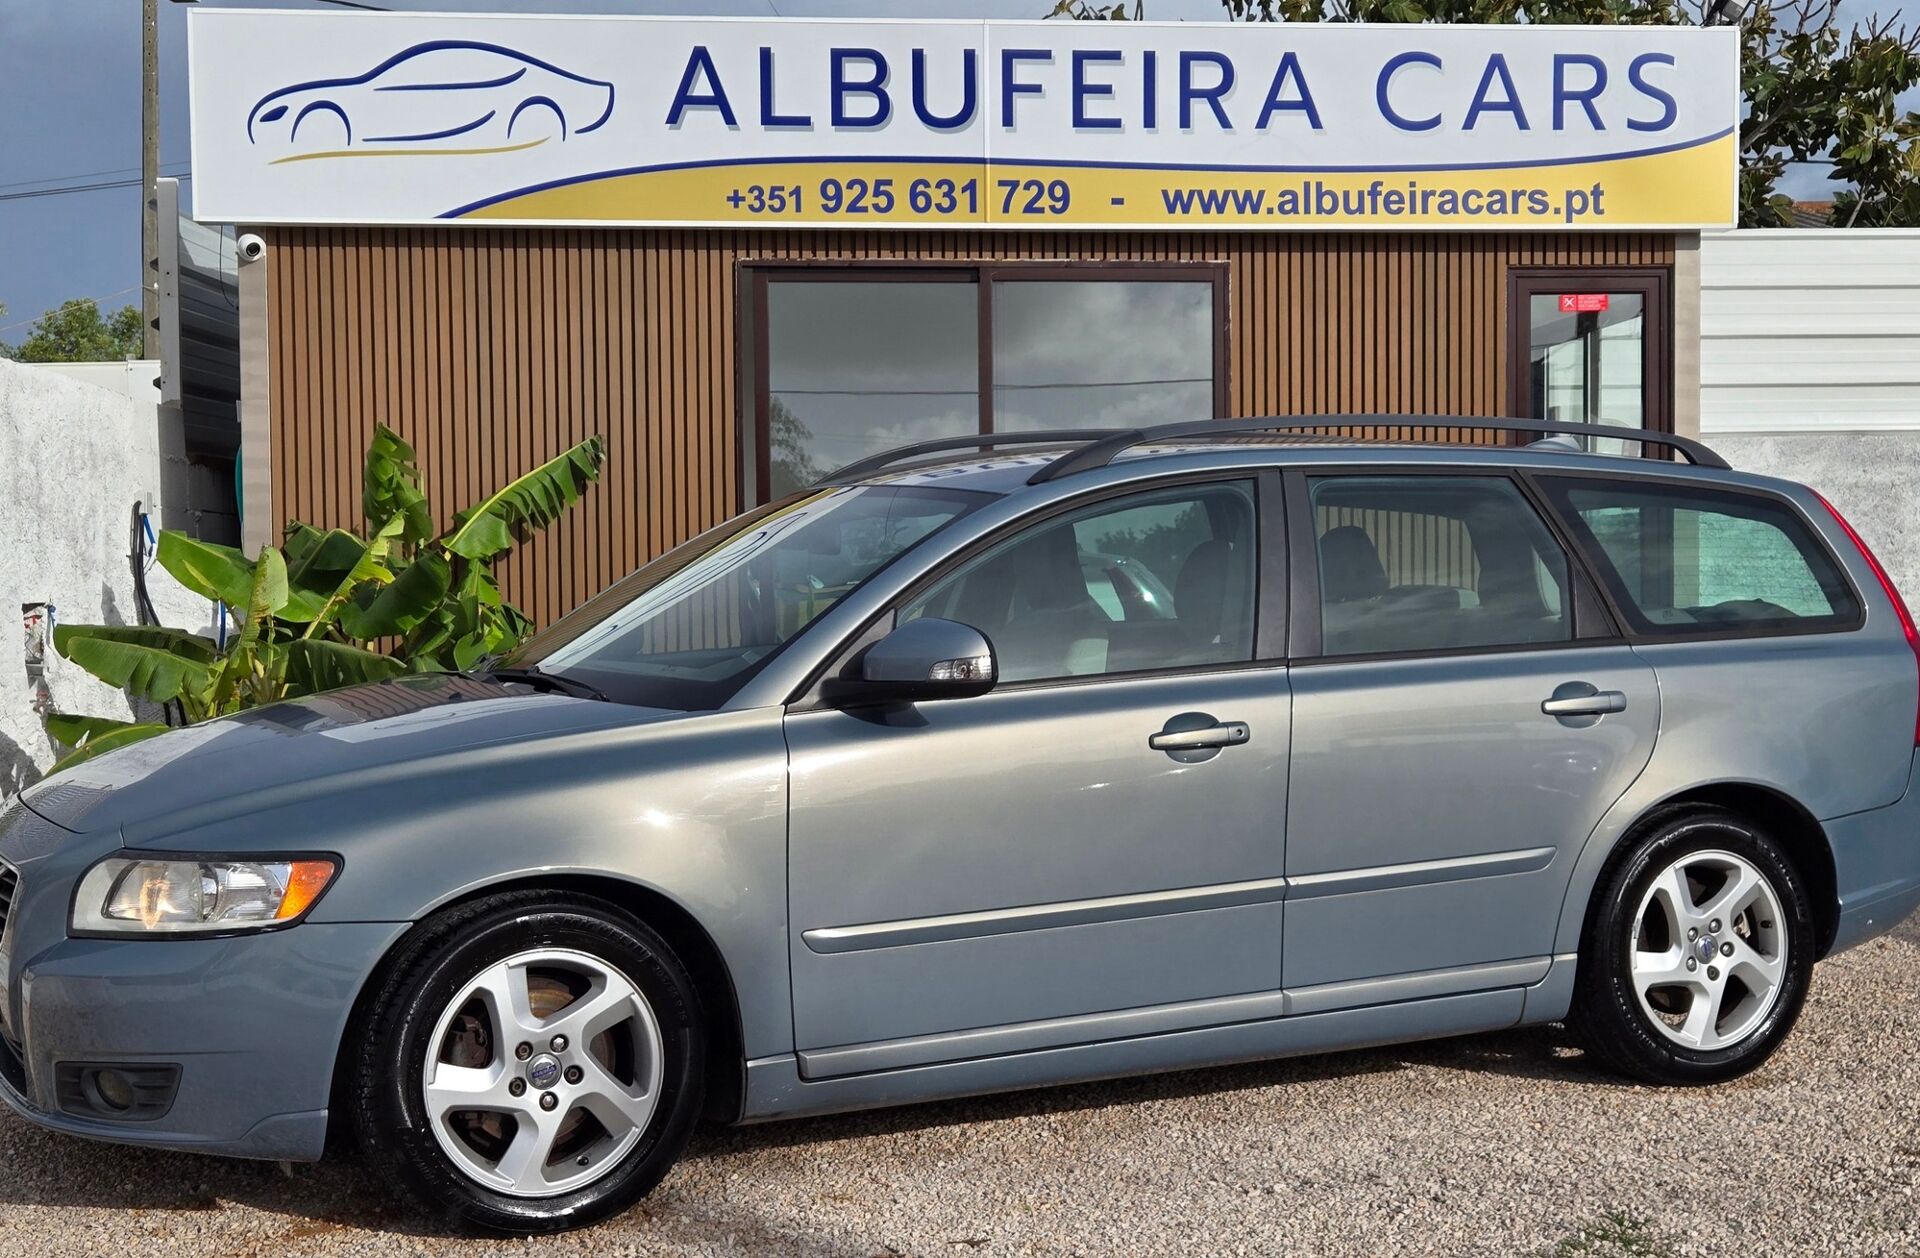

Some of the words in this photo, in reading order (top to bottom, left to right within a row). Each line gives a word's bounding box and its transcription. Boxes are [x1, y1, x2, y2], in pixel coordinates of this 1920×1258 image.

[665, 45, 1325, 132] ALBUFEIRA
[1376, 51, 1679, 133] CARS
[726, 185, 803, 213] +351
[819, 178, 895, 214] 925
[908, 178, 978, 214] 631
[997, 179, 1071, 215] 729
[1111, 197, 1125, 206] -
[1162, 181, 1606, 224] www.albufeiracars.pt
